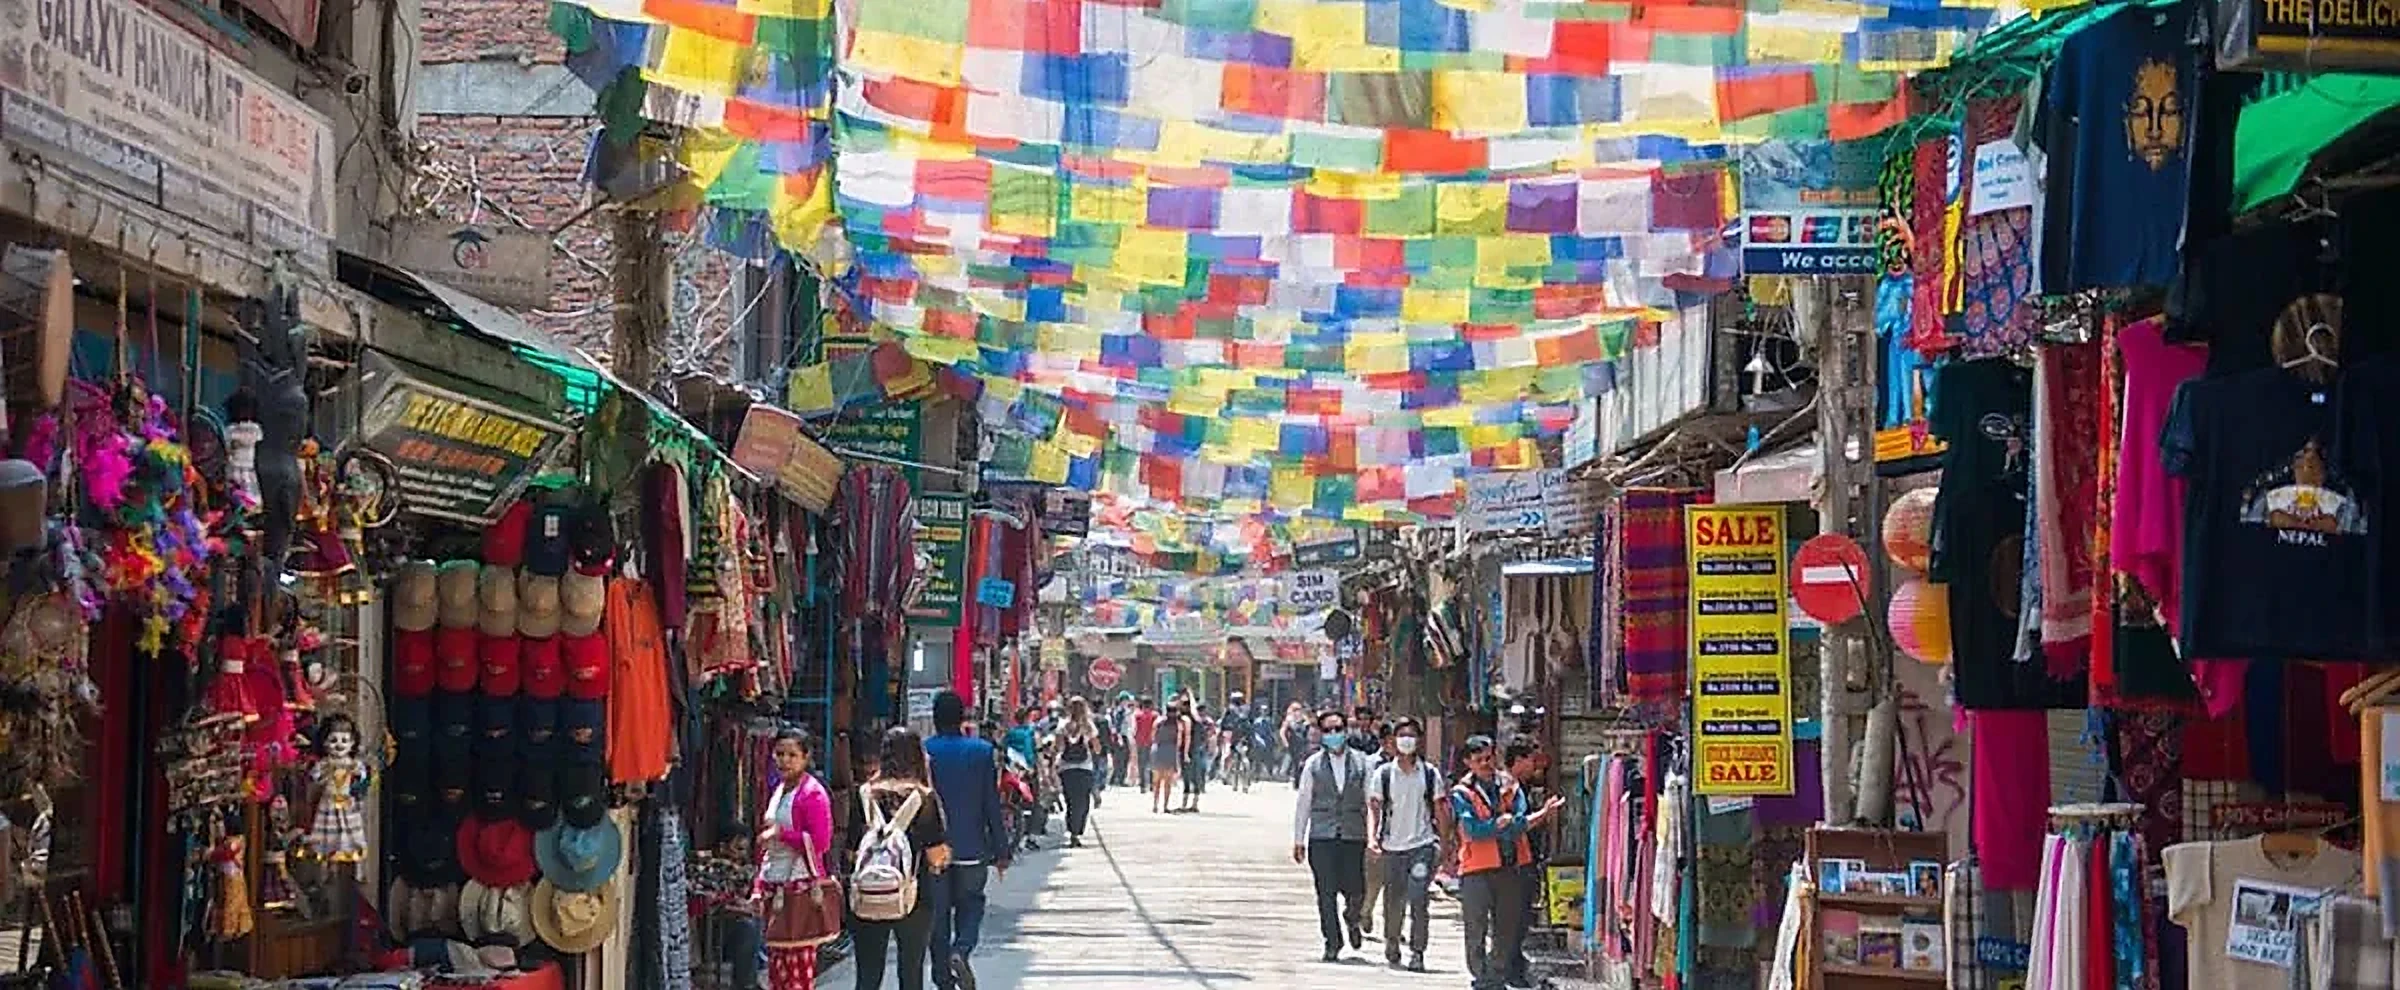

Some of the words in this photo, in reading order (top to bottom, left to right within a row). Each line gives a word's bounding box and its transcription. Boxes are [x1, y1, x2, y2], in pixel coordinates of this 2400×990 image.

[2264, 0, 2312, 23] THE
[37, 0, 127, 78] GALAXY
[134, 18, 244, 142] HANDICRAFT
[1781, 251, 1815, 268] We
[1697, 515, 1775, 546] SALE
[2277, 529, 2328, 547] NEPAL
[1296, 575, 1323, 589] SIM
[1290, 590, 1335, 604] CARD
[1711, 763, 1777, 781] SALE
